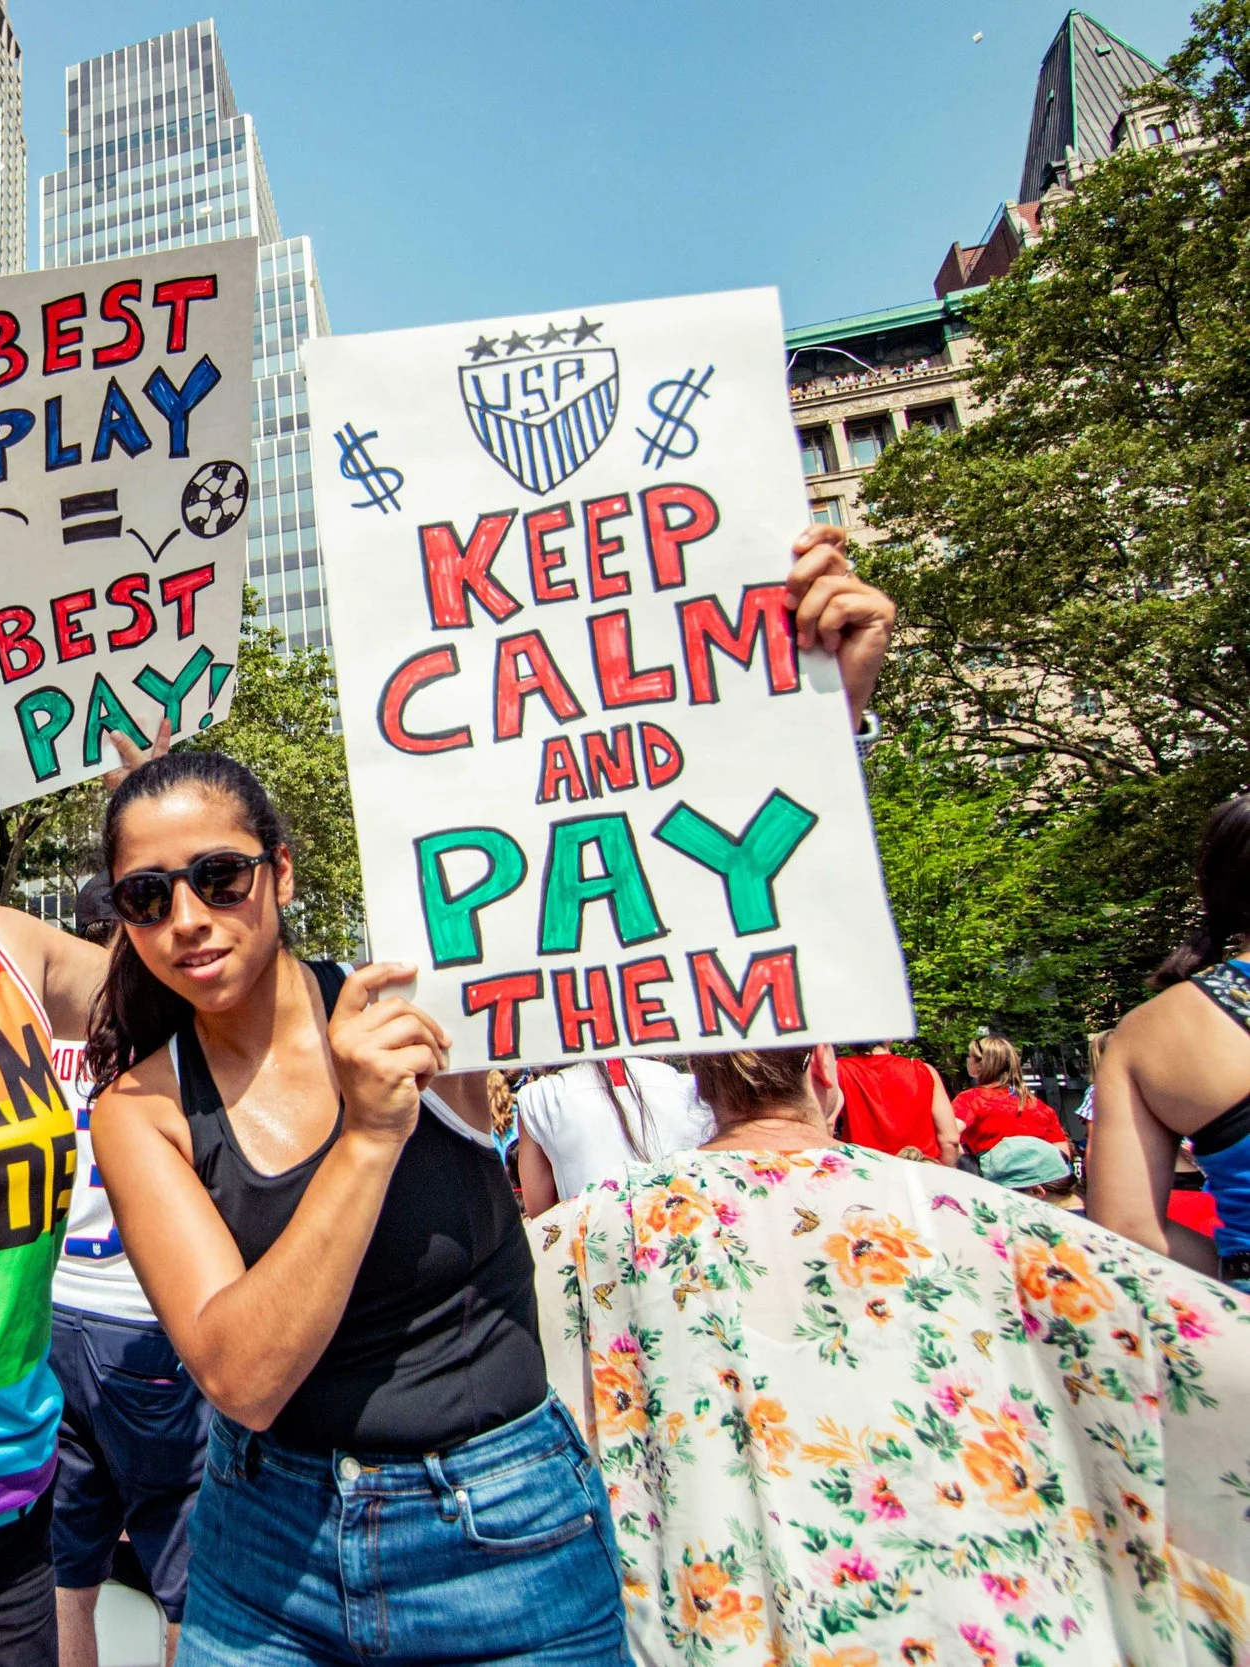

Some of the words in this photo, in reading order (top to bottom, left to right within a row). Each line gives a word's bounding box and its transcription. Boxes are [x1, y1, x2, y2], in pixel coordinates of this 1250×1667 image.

[471, 358, 586, 420] USA
[635, 364, 715, 470] $
[333, 422, 404, 514] $
[417, 482, 720, 630] KEEP
[14, 644, 234, 783] PAY!
[376, 583, 801, 756] CALM
[535, 721, 685, 805] AND
[412, 787, 819, 970] PAY
[461, 944, 808, 1061] THEM
